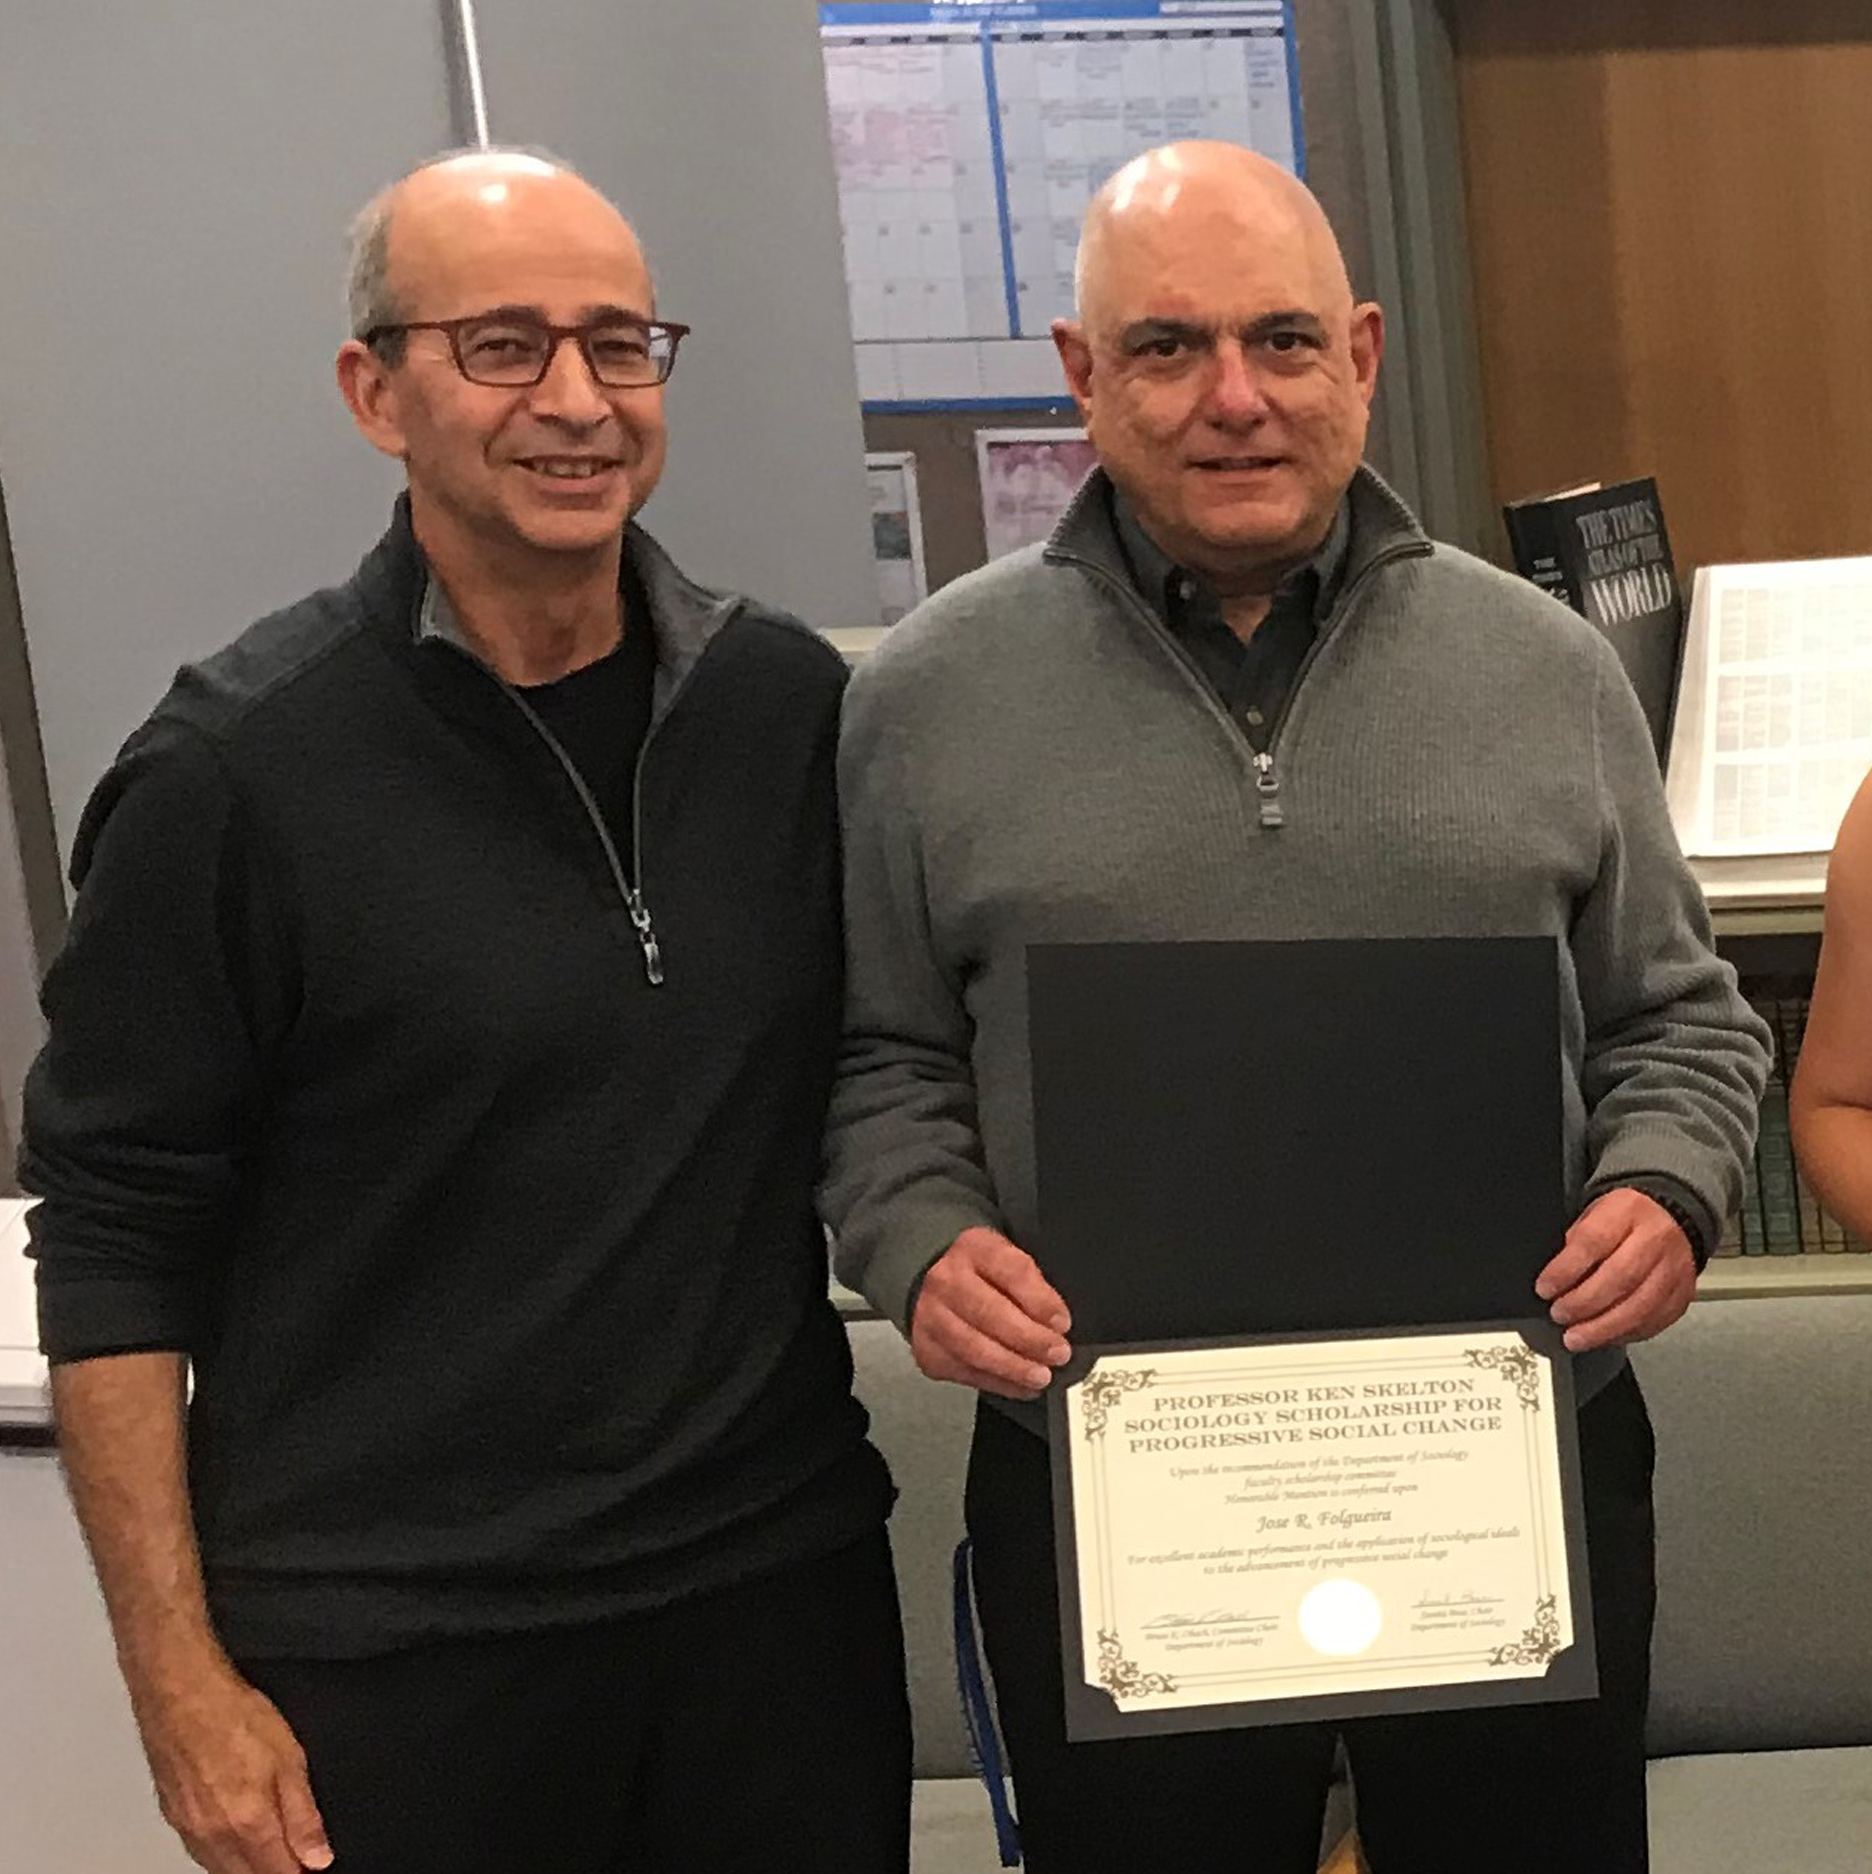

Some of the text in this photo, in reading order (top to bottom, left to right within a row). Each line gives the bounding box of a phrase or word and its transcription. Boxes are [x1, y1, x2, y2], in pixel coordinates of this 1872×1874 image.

[1590, 563, 1672, 627] WORLD
[1153, 1378, 1475, 1413] PROFESSOR KEN SKELTON
[1124, 1396, 1503, 1434] SOCIOLOGY SCHOLARSHIP FOR
[1129, 1415, 1502, 1454] PROGRESSIVE SOCIAL CHANGE
[1255, 1507, 1392, 1534] Jose R. Folgueira
